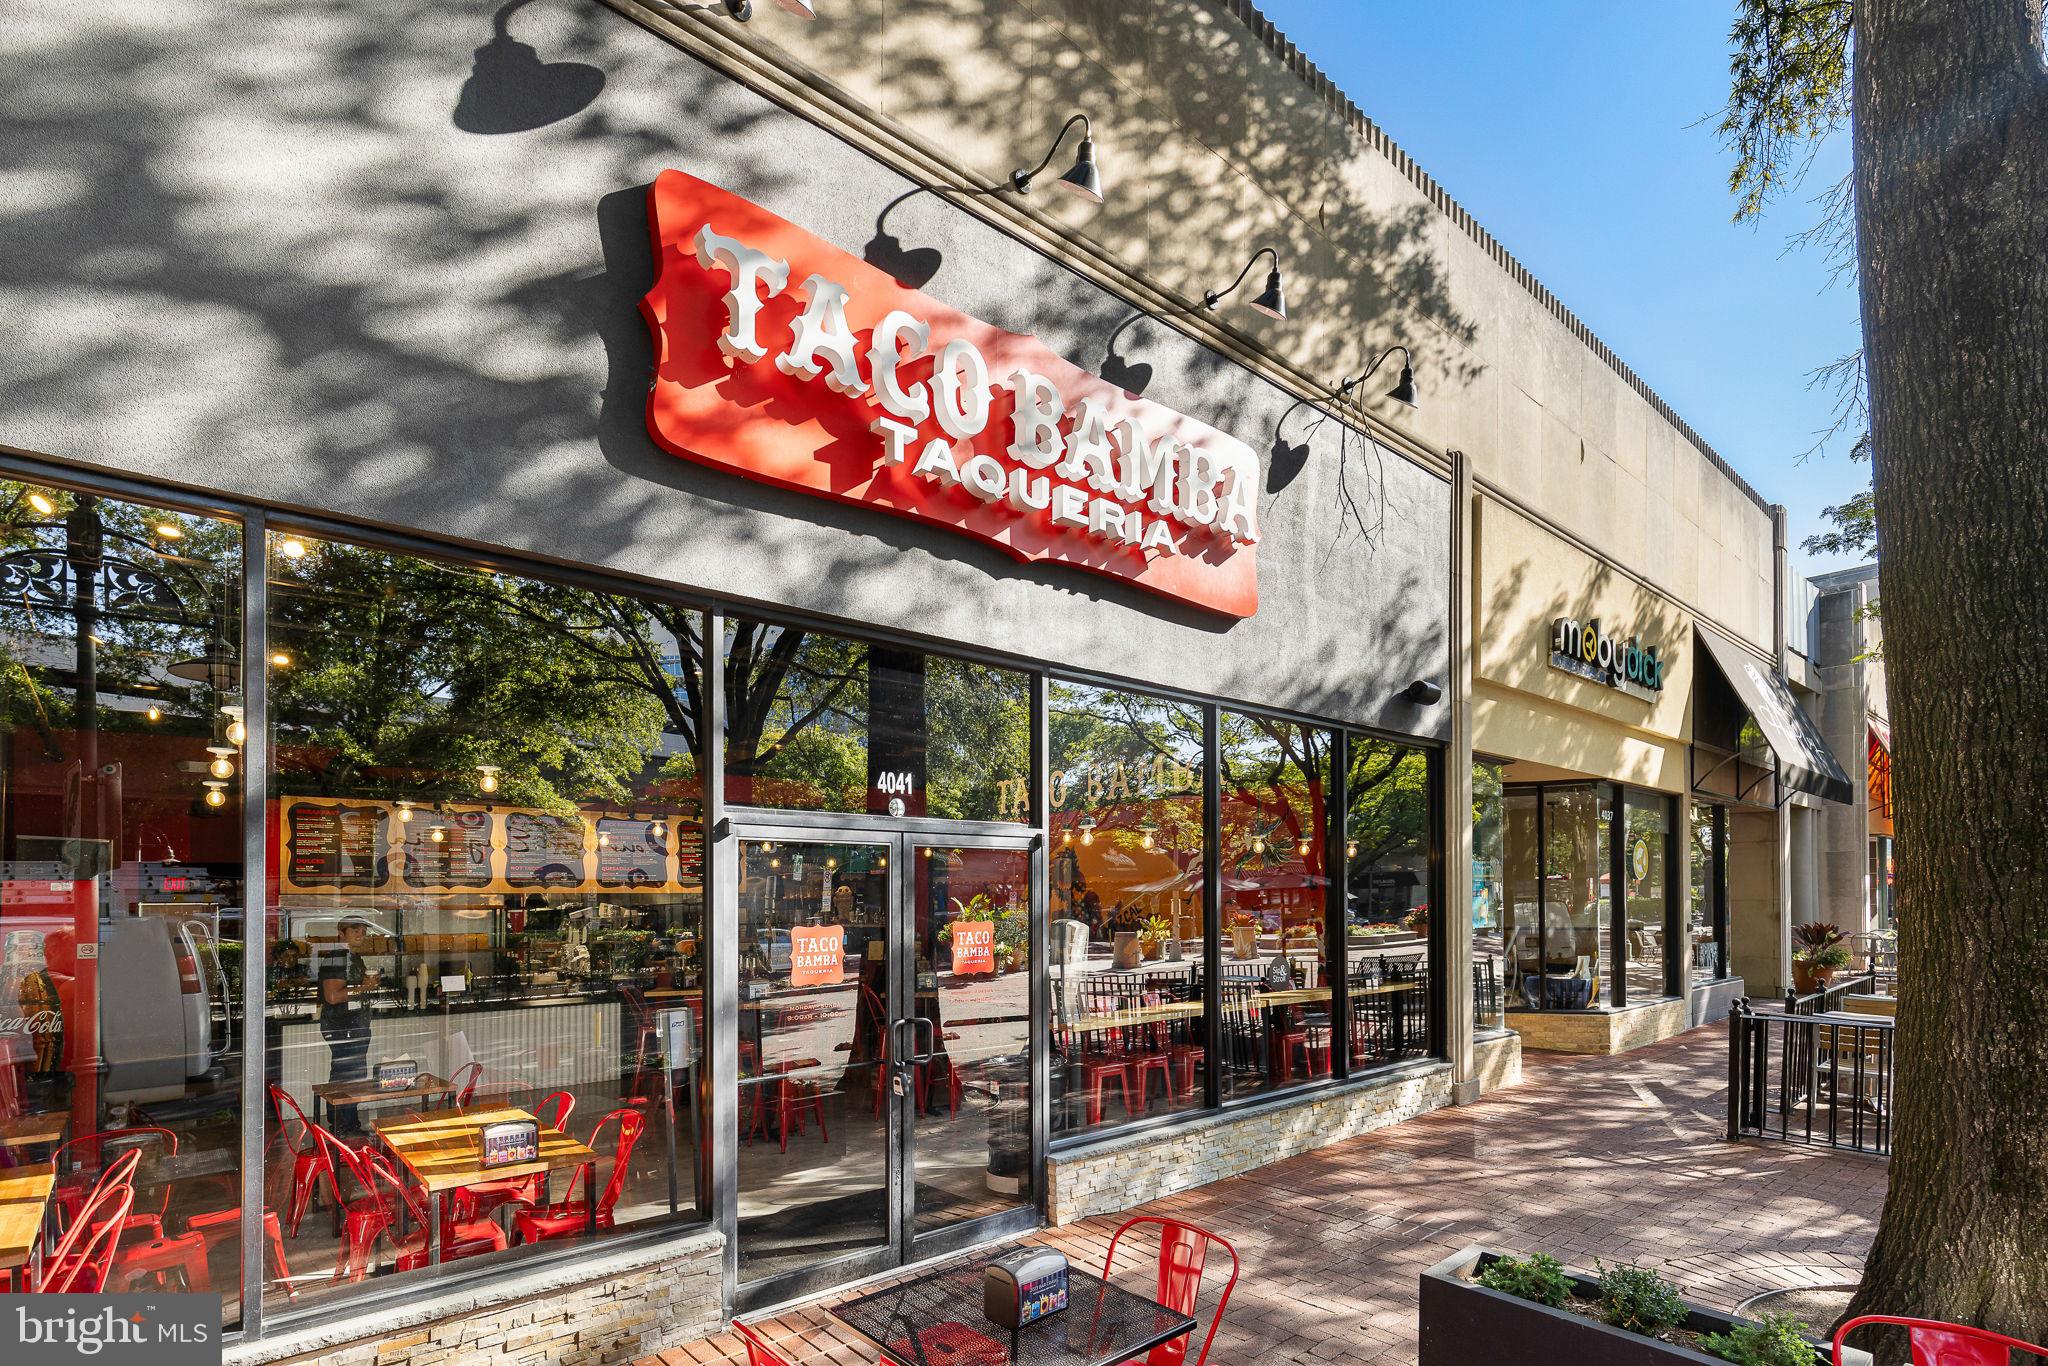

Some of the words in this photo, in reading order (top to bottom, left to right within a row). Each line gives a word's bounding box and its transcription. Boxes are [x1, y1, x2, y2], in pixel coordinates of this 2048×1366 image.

[694, 222, 992, 441] TACO
[1007, 368, 1262, 544] BAMBA
[871, 416, 1177, 556] TAQUERIA
[877, 771, 913, 795] 4041
[997, 770, 1067, 814] TAO
[1087, 753, 1227, 802] BAMB
[1601, 810, 1614, 821] 4037
[797, 936, 838, 953] TACO
[957, 931, 990, 945] TACO
[957, 946, 990, 958] BAMBA
[797, 954, 838, 968] BAMBA
